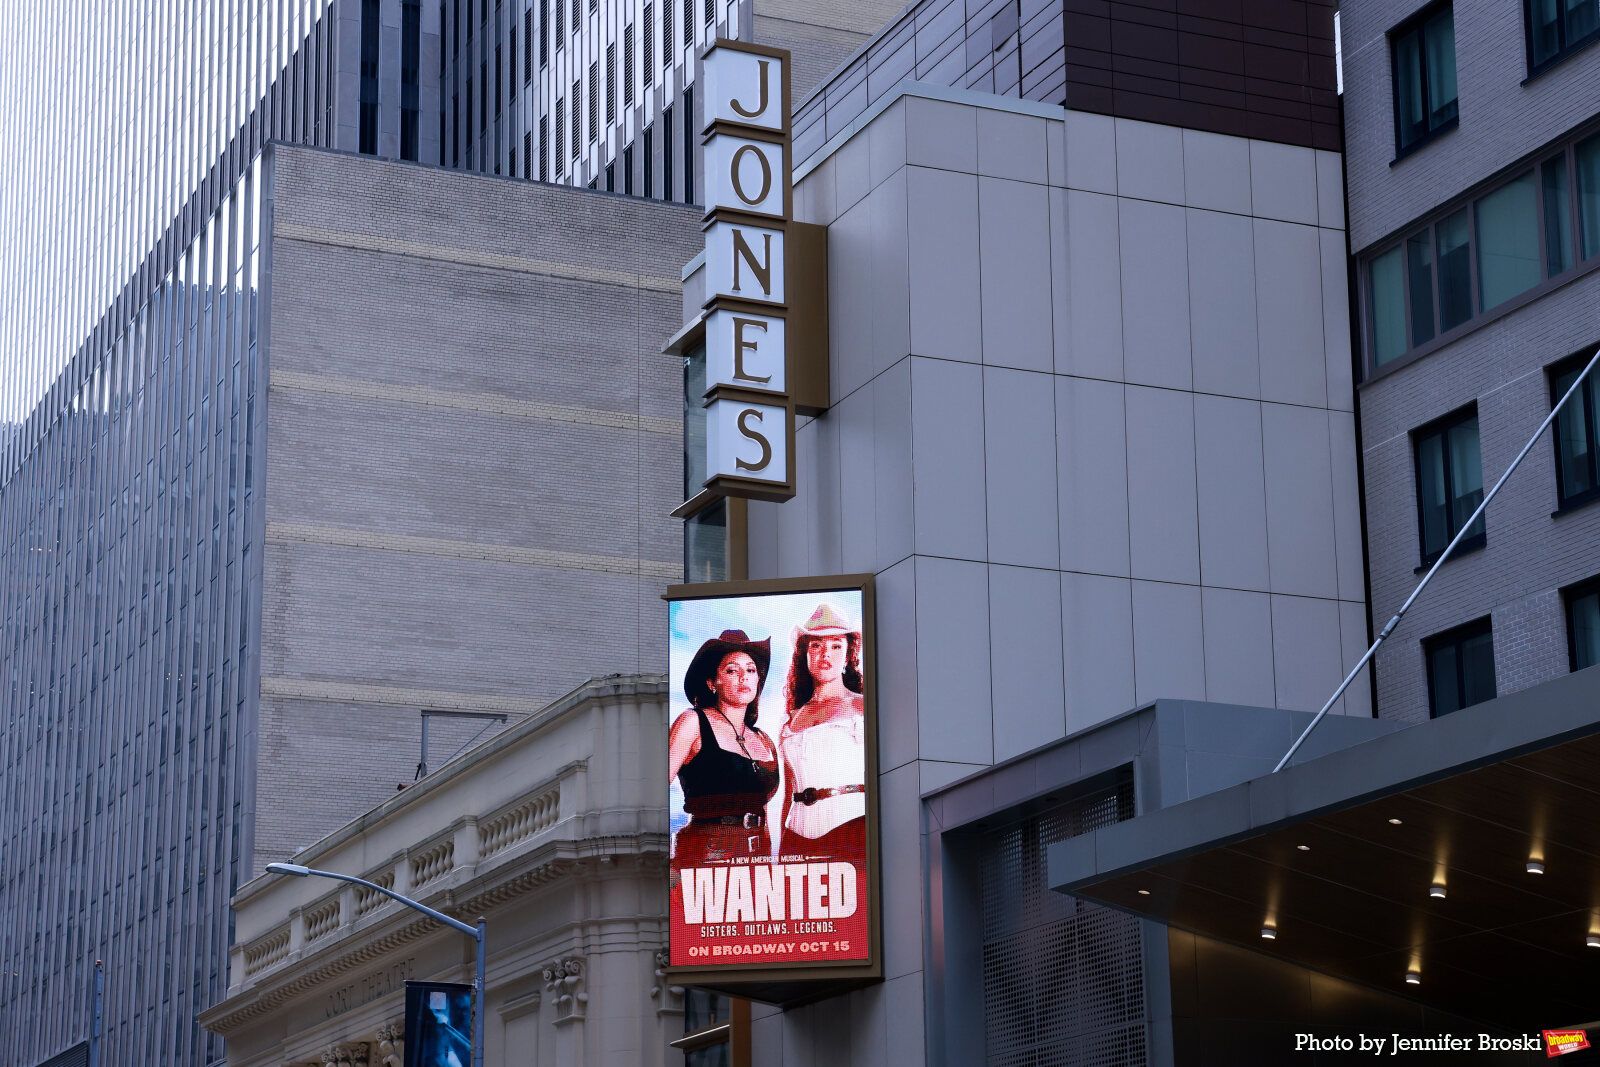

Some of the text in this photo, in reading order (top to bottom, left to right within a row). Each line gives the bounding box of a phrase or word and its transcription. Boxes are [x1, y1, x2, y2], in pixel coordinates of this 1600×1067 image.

[729, 60, 772, 472] JONES
[781, 855, 805, 863] MUSICAL
[680, 861, 857, 924] WANTED
[701, 921, 837, 937] SISTERS. OUTLAWS. LEGENDS.
[689, 940, 850, 957] ON BROADWAY OCT 15
